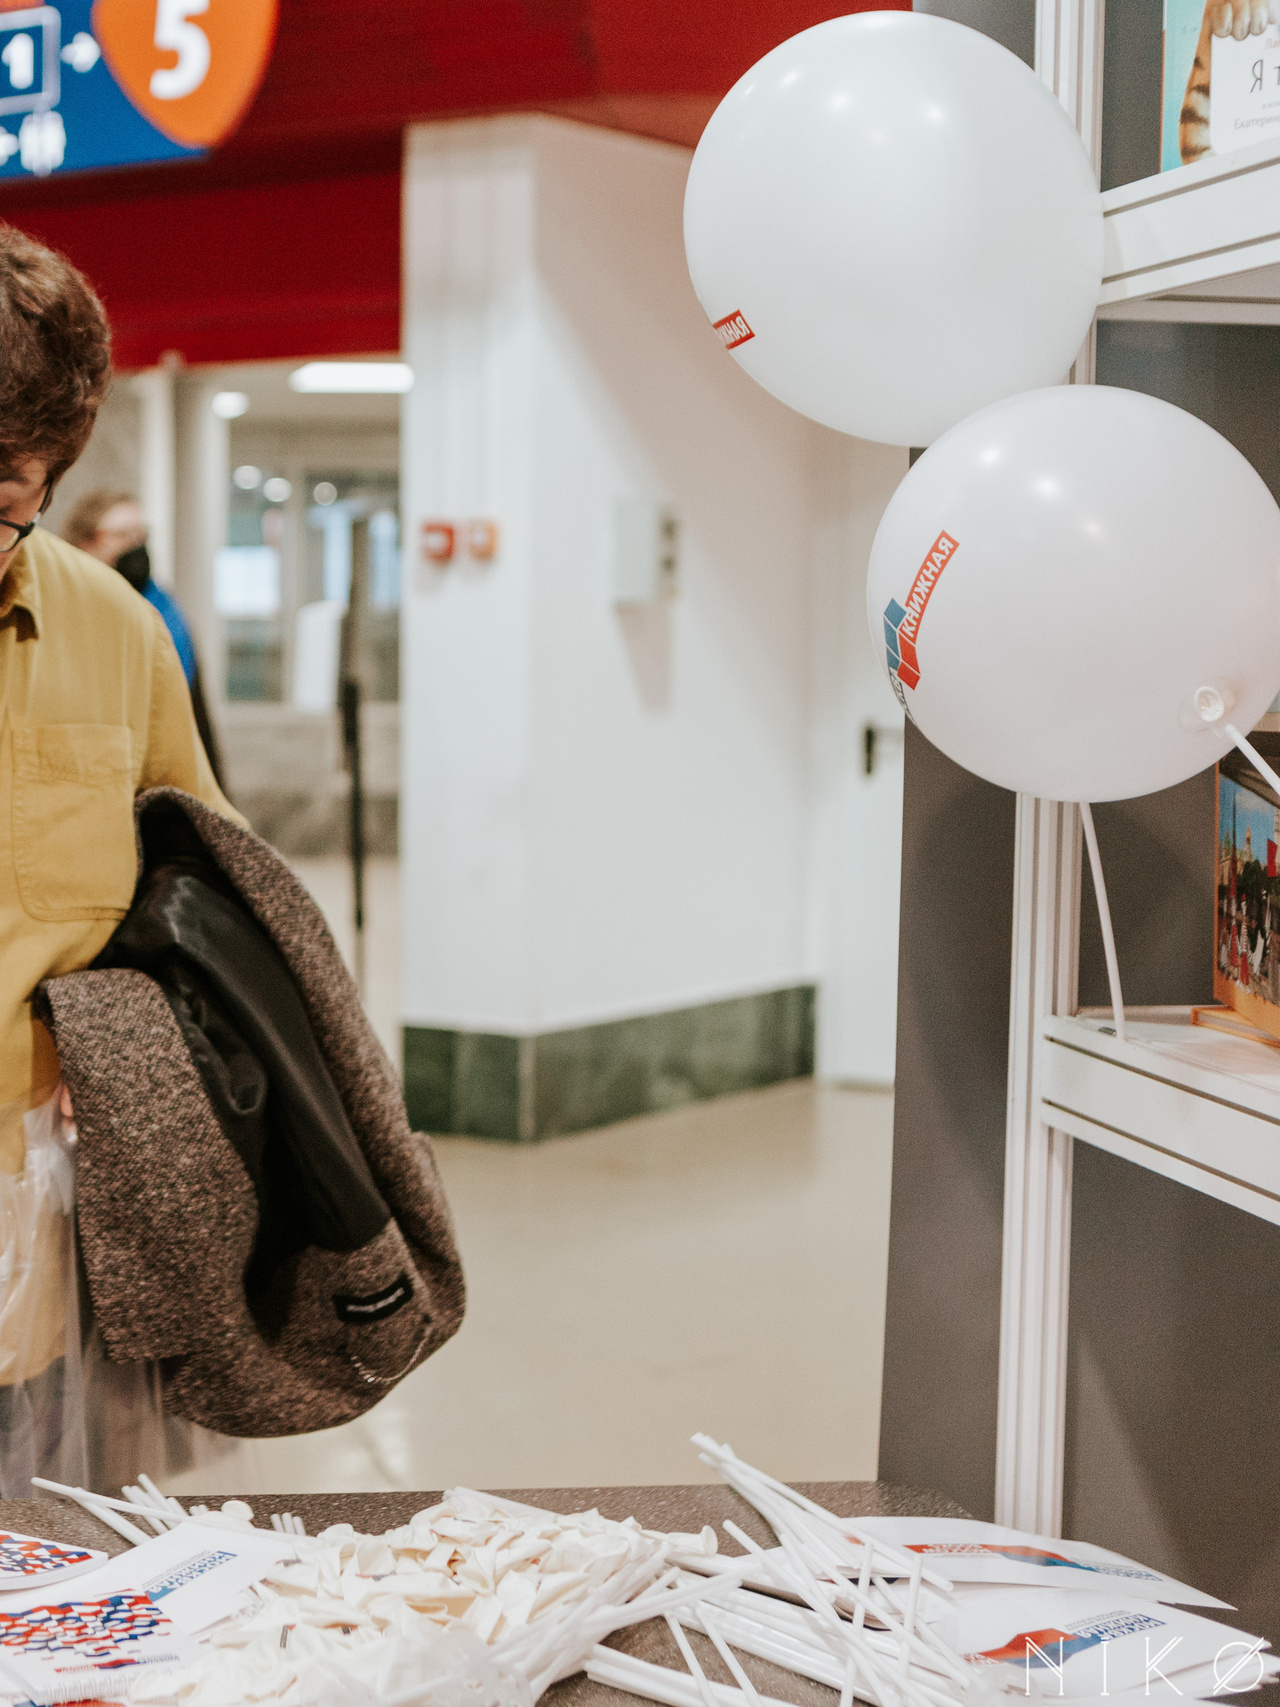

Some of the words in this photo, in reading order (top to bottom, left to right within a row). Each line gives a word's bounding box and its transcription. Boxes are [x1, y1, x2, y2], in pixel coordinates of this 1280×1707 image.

[2, 33, 35, 89] 1
[149, 0, 212, 101] 5
[1234, 112, 1280, 131] Екатерин
[901, 536, 954, 638] КНИЖНАЯ
